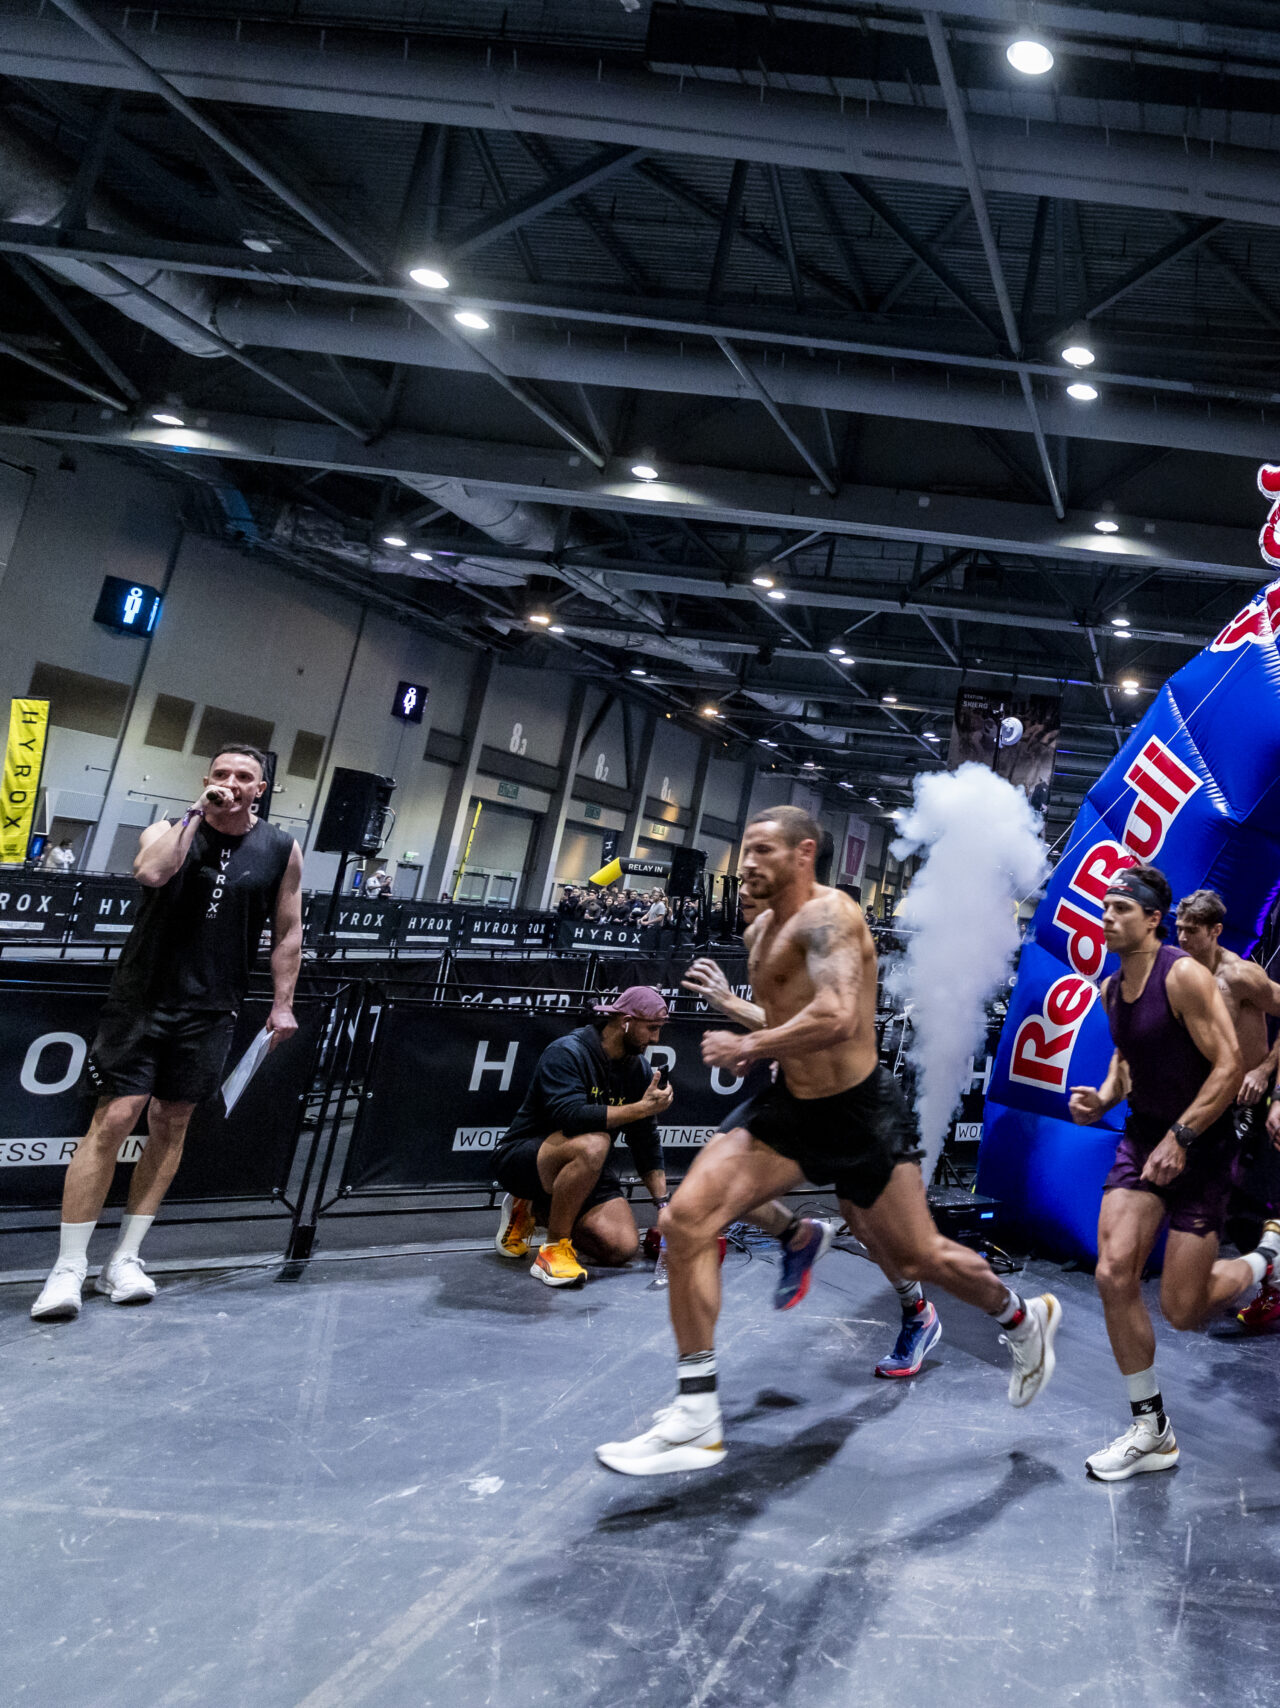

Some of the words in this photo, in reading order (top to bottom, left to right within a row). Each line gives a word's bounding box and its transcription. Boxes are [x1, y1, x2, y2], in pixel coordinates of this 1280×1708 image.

[4, 710, 39, 830] HYROX
[628, 863, 653, 872] RELAY
[207, 848, 231, 914] HYROX
[408, 917, 453, 932] HYROX
[473, 923, 519, 936] HYROX
[574, 927, 642, 944] HYROX
